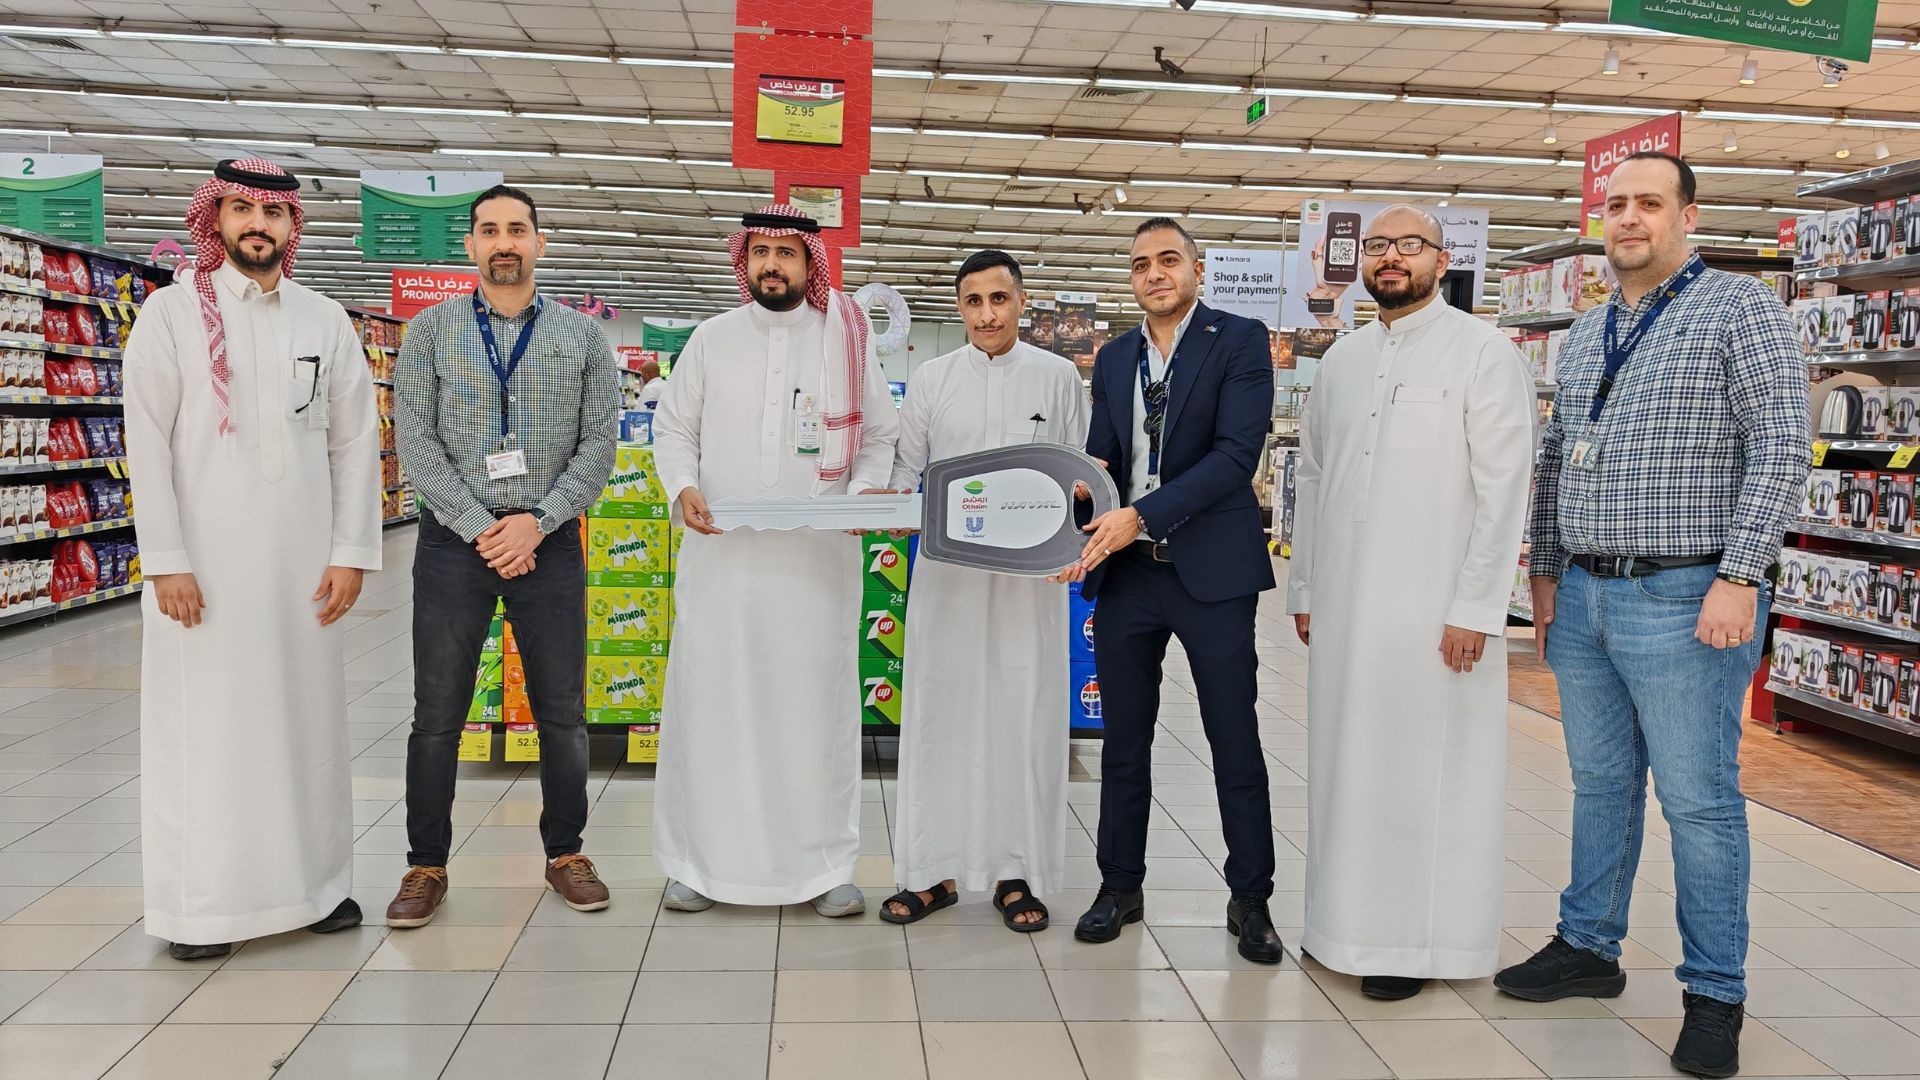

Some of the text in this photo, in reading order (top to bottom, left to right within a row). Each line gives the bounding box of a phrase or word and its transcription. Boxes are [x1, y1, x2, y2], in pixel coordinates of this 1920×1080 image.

[1643, 4, 1687, 16] للمستفيد
[1687, 10, 1713, 21] الصورة
[1745, 19, 1767, 30] العامة
[1747, 8, 1840, 30] من الكاشير عند زيارتك
[1787, 28, 1799, 36] من
[1807, 30, 1839, 41] للفرع
[770, 80, 817, 92] عرض خاص
[784, 105, 815, 117] 52.95
[1591, 139, 1629, 173] خاص
[22, 157, 35, 175] 2
[426, 175, 436, 192] 1
[1450, 253, 1476, 266] فاتورت
[398, 276, 472, 291] عرض خاص
[1213, 272, 1273, 284] Shop & split
[1213, 286, 1288, 296] your payments
[651, 506, 664, 514] 24
[651, 574, 664, 584] 24
[890, 593, 903, 603] 24
[650, 643, 663, 652] 24
[887, 661, 900, 670] 24
[482, 706, 493, 716] 24
[649, 711, 661, 720] 24
[517, 738, 538, 747] 52.9
[639, 740, 660, 748] 52.9
